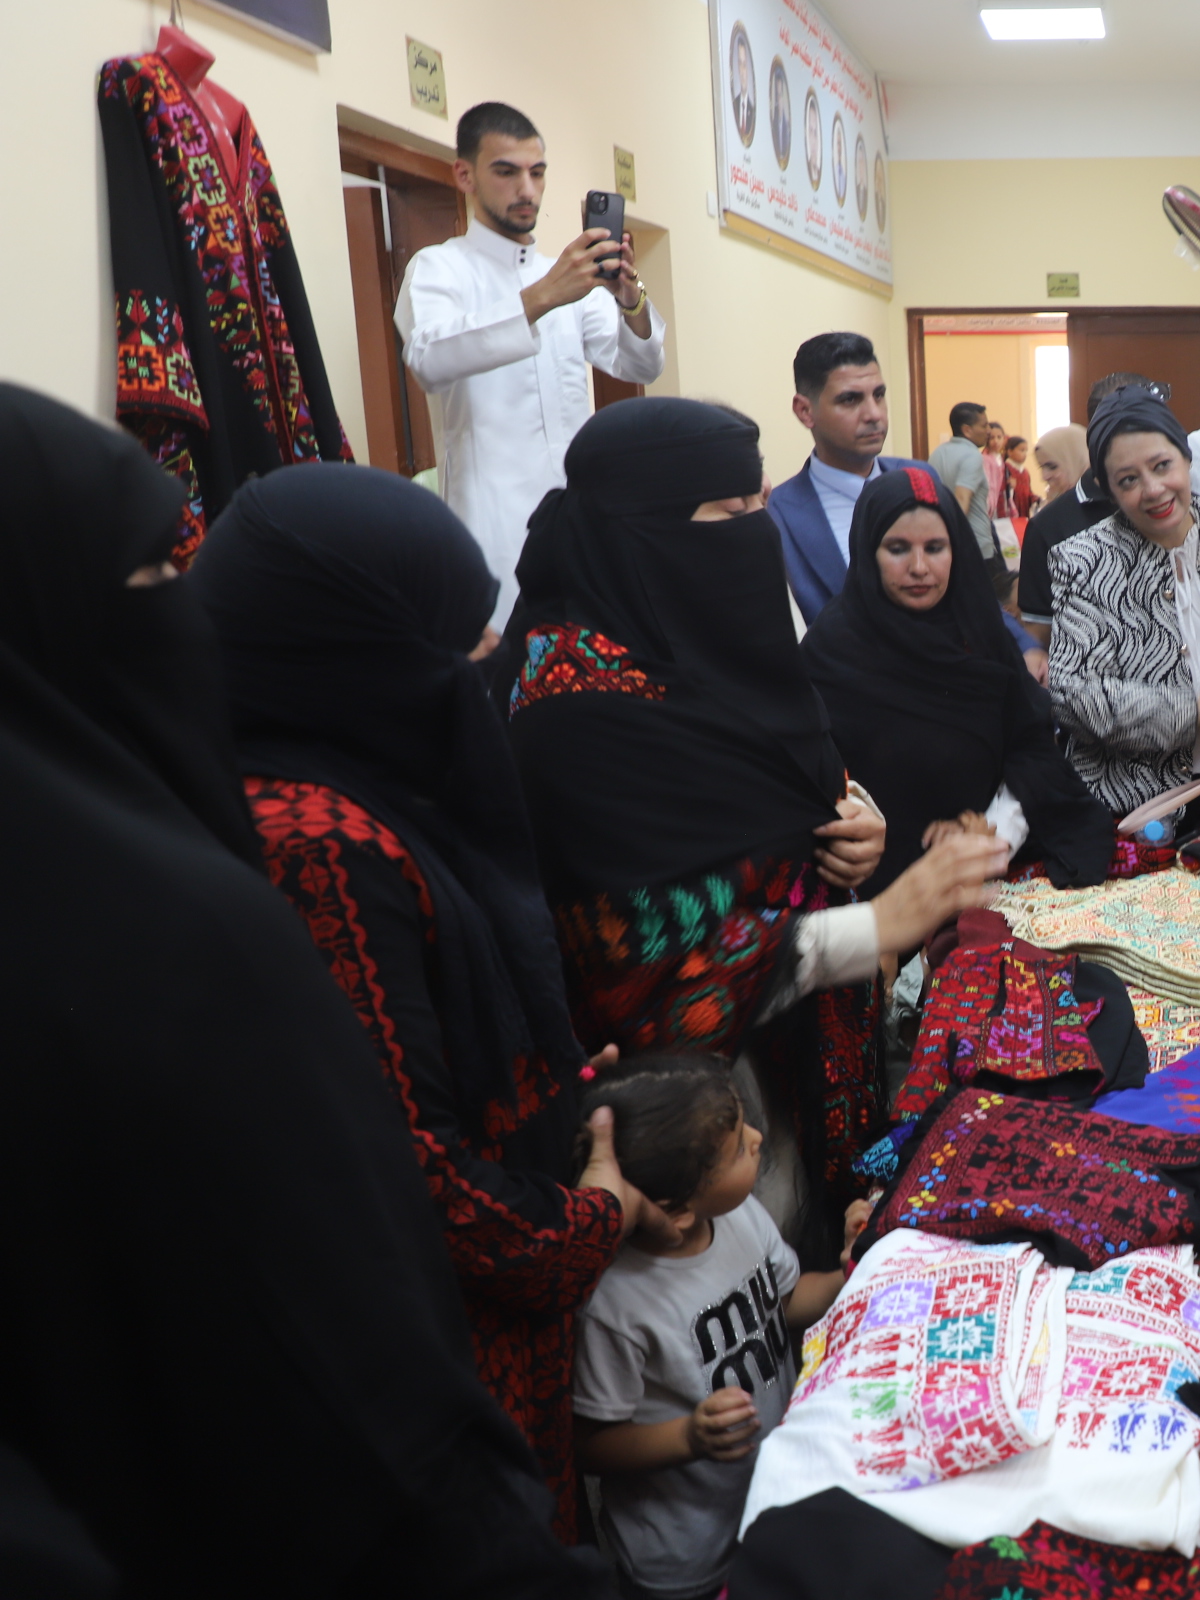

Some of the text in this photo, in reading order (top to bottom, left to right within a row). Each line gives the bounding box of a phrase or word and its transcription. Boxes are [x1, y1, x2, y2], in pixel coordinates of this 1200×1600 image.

[413, 45, 437, 76] مركز
[416, 83, 440, 104] تدريب
[731, 163, 748, 185] منصور
[694, 1255, 780, 1366] miu
